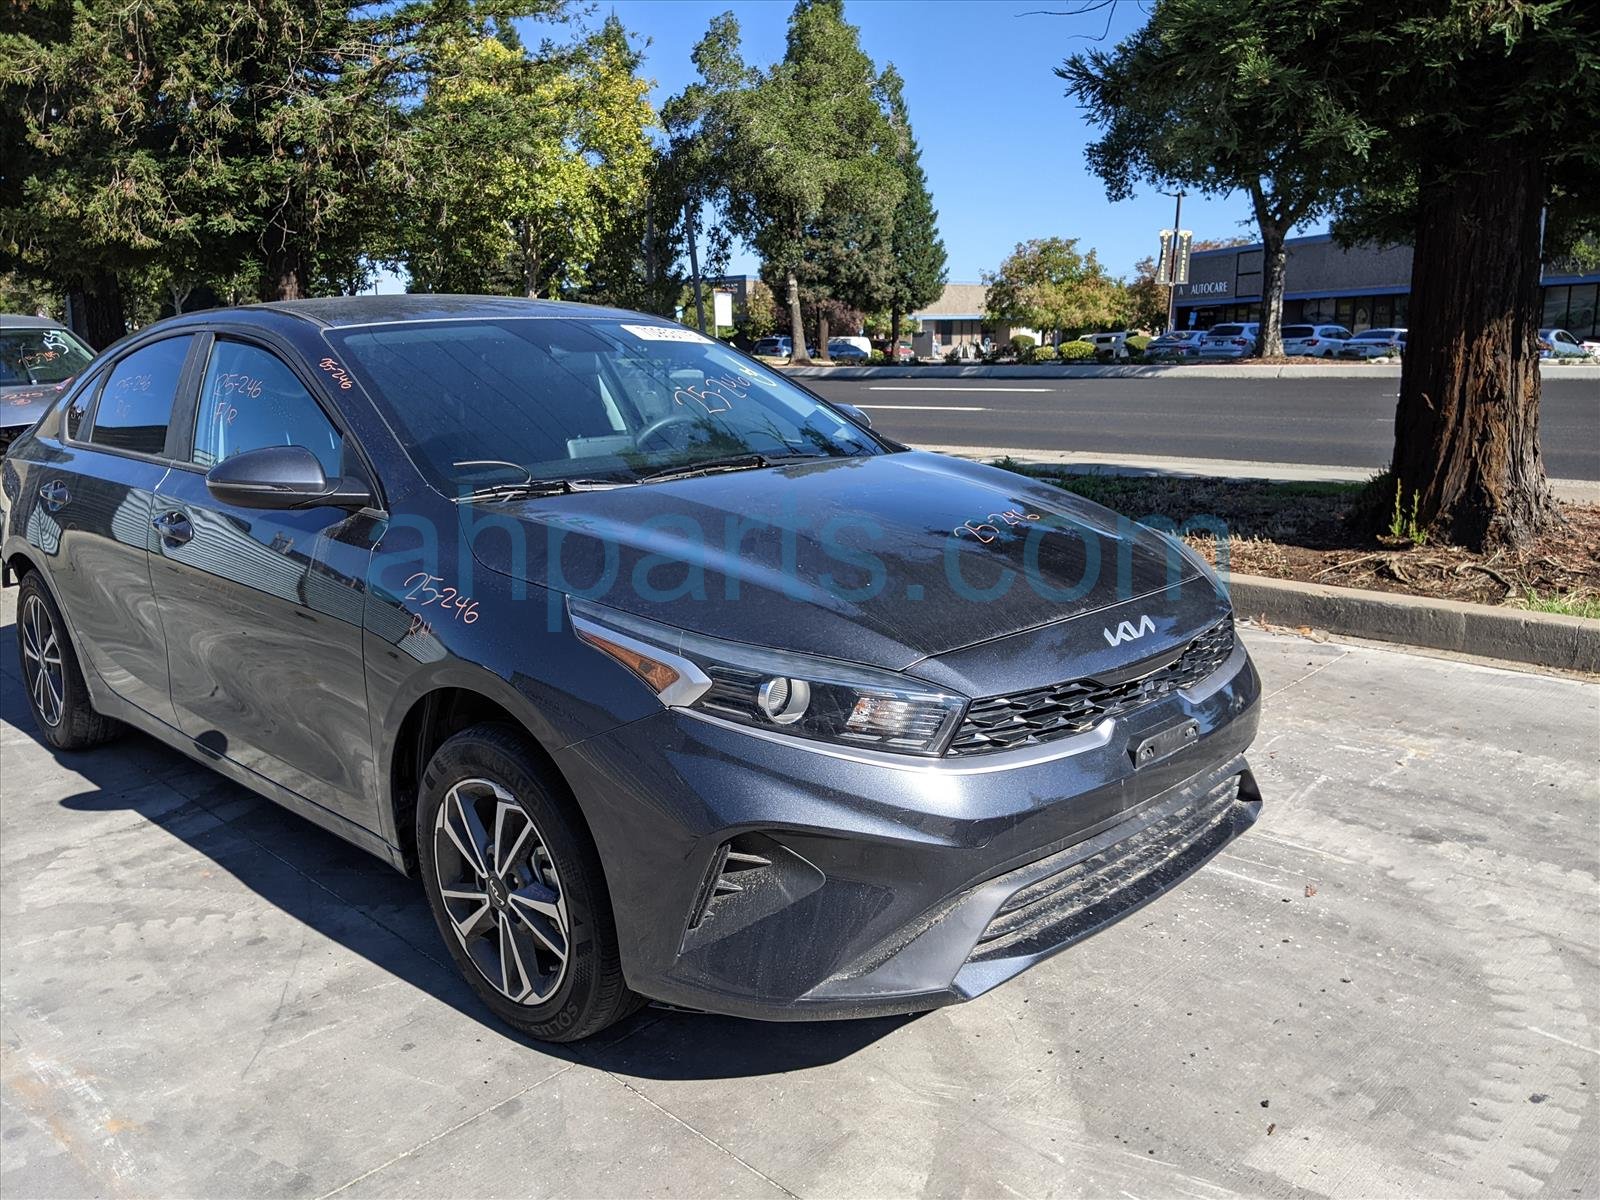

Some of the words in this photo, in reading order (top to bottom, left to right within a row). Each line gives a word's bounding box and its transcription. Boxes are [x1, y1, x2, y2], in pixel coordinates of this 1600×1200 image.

[1190, 281, 1229, 295] AUTOCARE
[403, 571, 480, 625] 25-246
[1103, 614, 1156, 647] KIA
